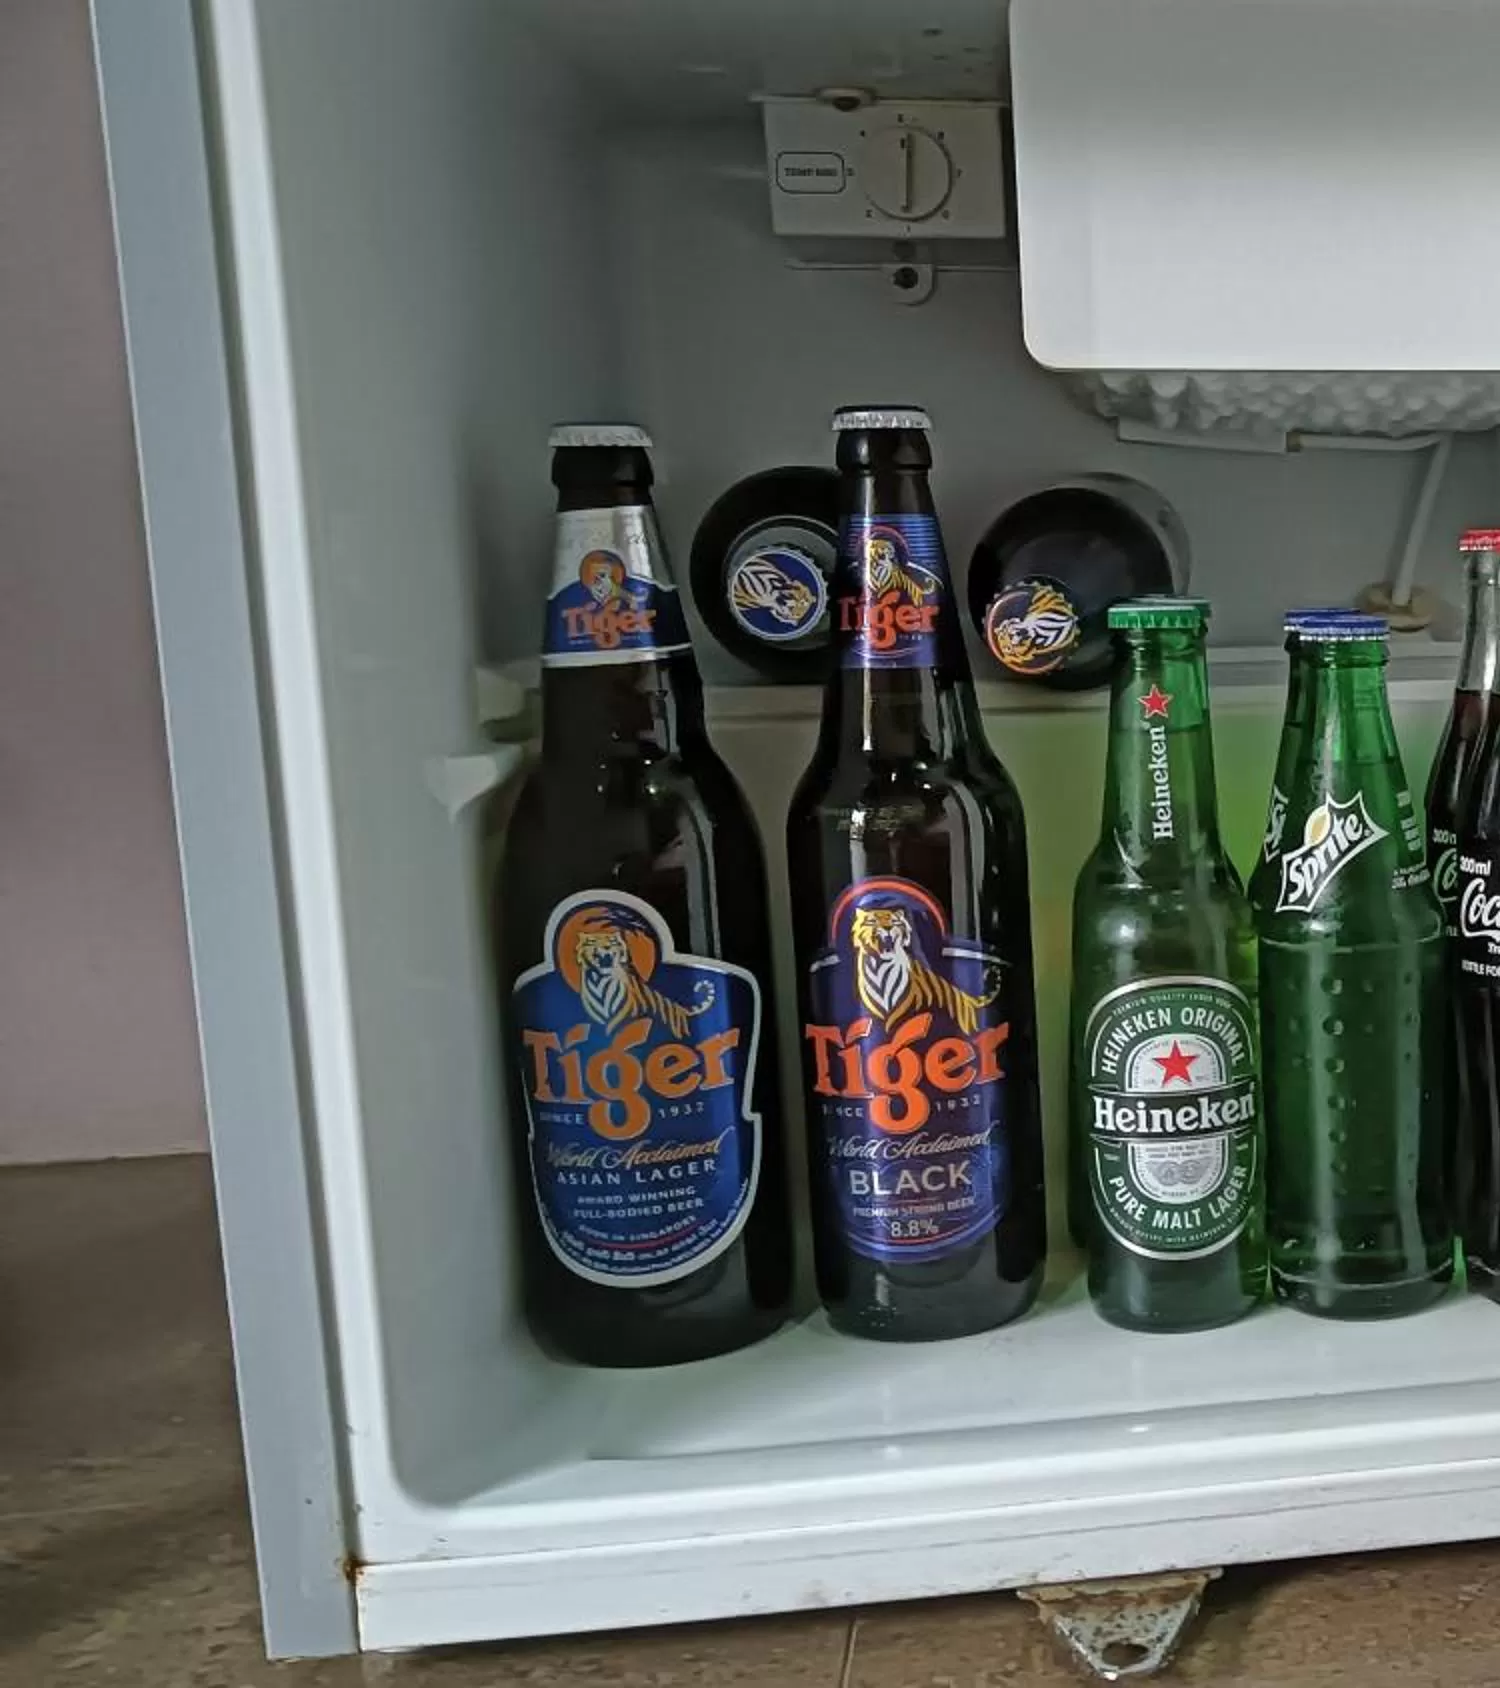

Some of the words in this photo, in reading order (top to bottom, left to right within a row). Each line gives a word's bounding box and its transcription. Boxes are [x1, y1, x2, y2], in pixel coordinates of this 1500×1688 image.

[562, 597, 657, 650] Tiger
[837, 590, 940, 650] Tiger
[1148, 725, 1176, 840] Heineken
[1288, 812, 1364, 905] Sprite
[1459, 855, 1492, 876] 300ml
[1101, 1007, 1173, 1075] HEINEKEN
[1180, 1007, 1246, 1067] ORIGINAL
[523, 1018, 741, 1141] Tiger
[805, 1012, 1011, 1135] Tiger
[657, 1101, 705, 1119] 1932
[1092, 1081, 1256, 1134] Heineken
[556, 1171, 621, 1186] ASIAN
[634, 1159, 718, 1184] LAGER
[627, 1185, 698, 1202] WINNING
[850, 1160, 973, 1196] BLACK
[1108, 1175, 1148, 1222] PURE
[1152, 1210, 1202, 1231] MALT
[1207, 1165, 1248, 1221] LAGER
[573, 1204, 663, 1220] FULL-BODIED
[667, 1197, 705, 1213] BEER
[890, 1217, 940, 1238] 8.8%
